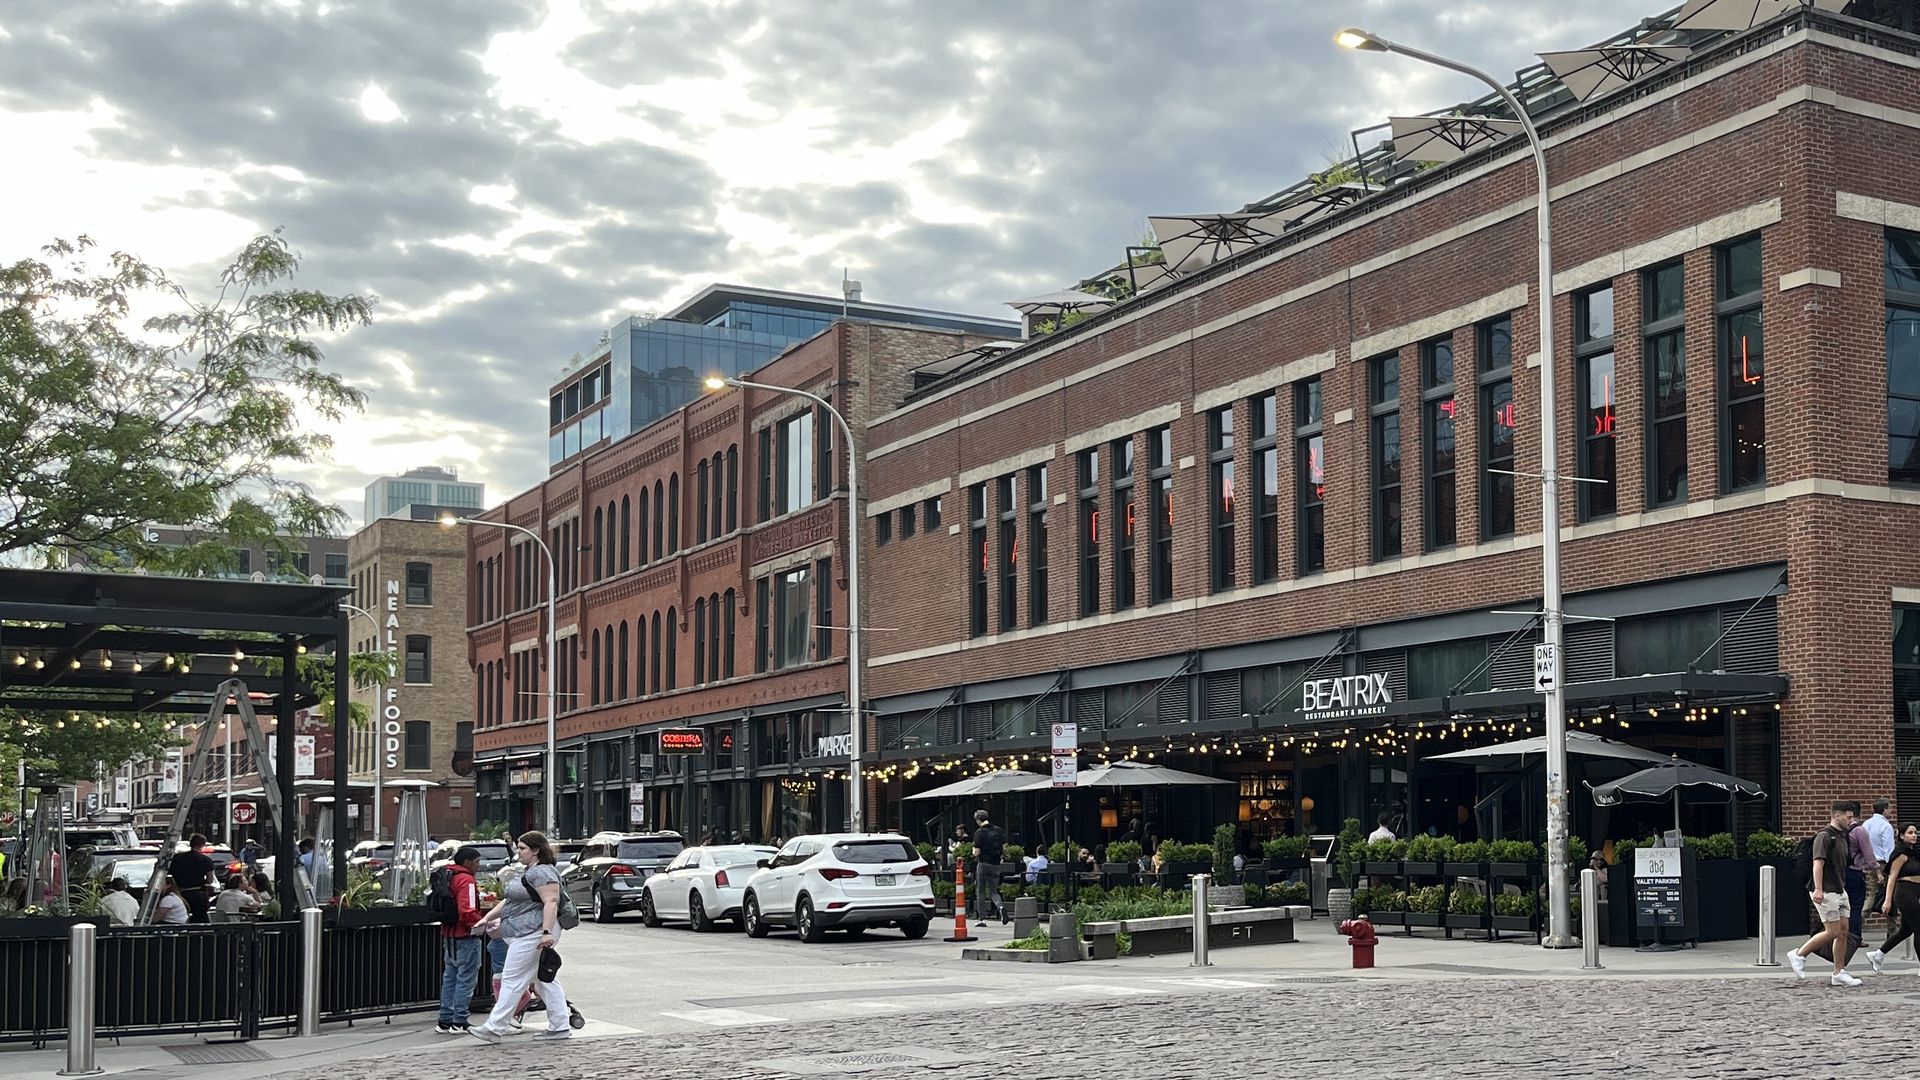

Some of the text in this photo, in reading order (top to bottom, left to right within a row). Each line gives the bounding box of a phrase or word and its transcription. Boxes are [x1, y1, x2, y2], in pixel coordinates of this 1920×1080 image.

[1537, 647, 1553, 659] ONE
[1537, 661, 1553, 672] WAY
[1303, 672, 1391, 711] BEATRIX
[1305, 710, 1349, 720] RESTAURANT
[1357, 706, 1386, 716] MARKET
[385, 688, 400, 768] FOODS
[818, 733, 852, 758] MARKE
[234, 809, 255, 818] STOP
[1649, 859, 1664, 874] aba
